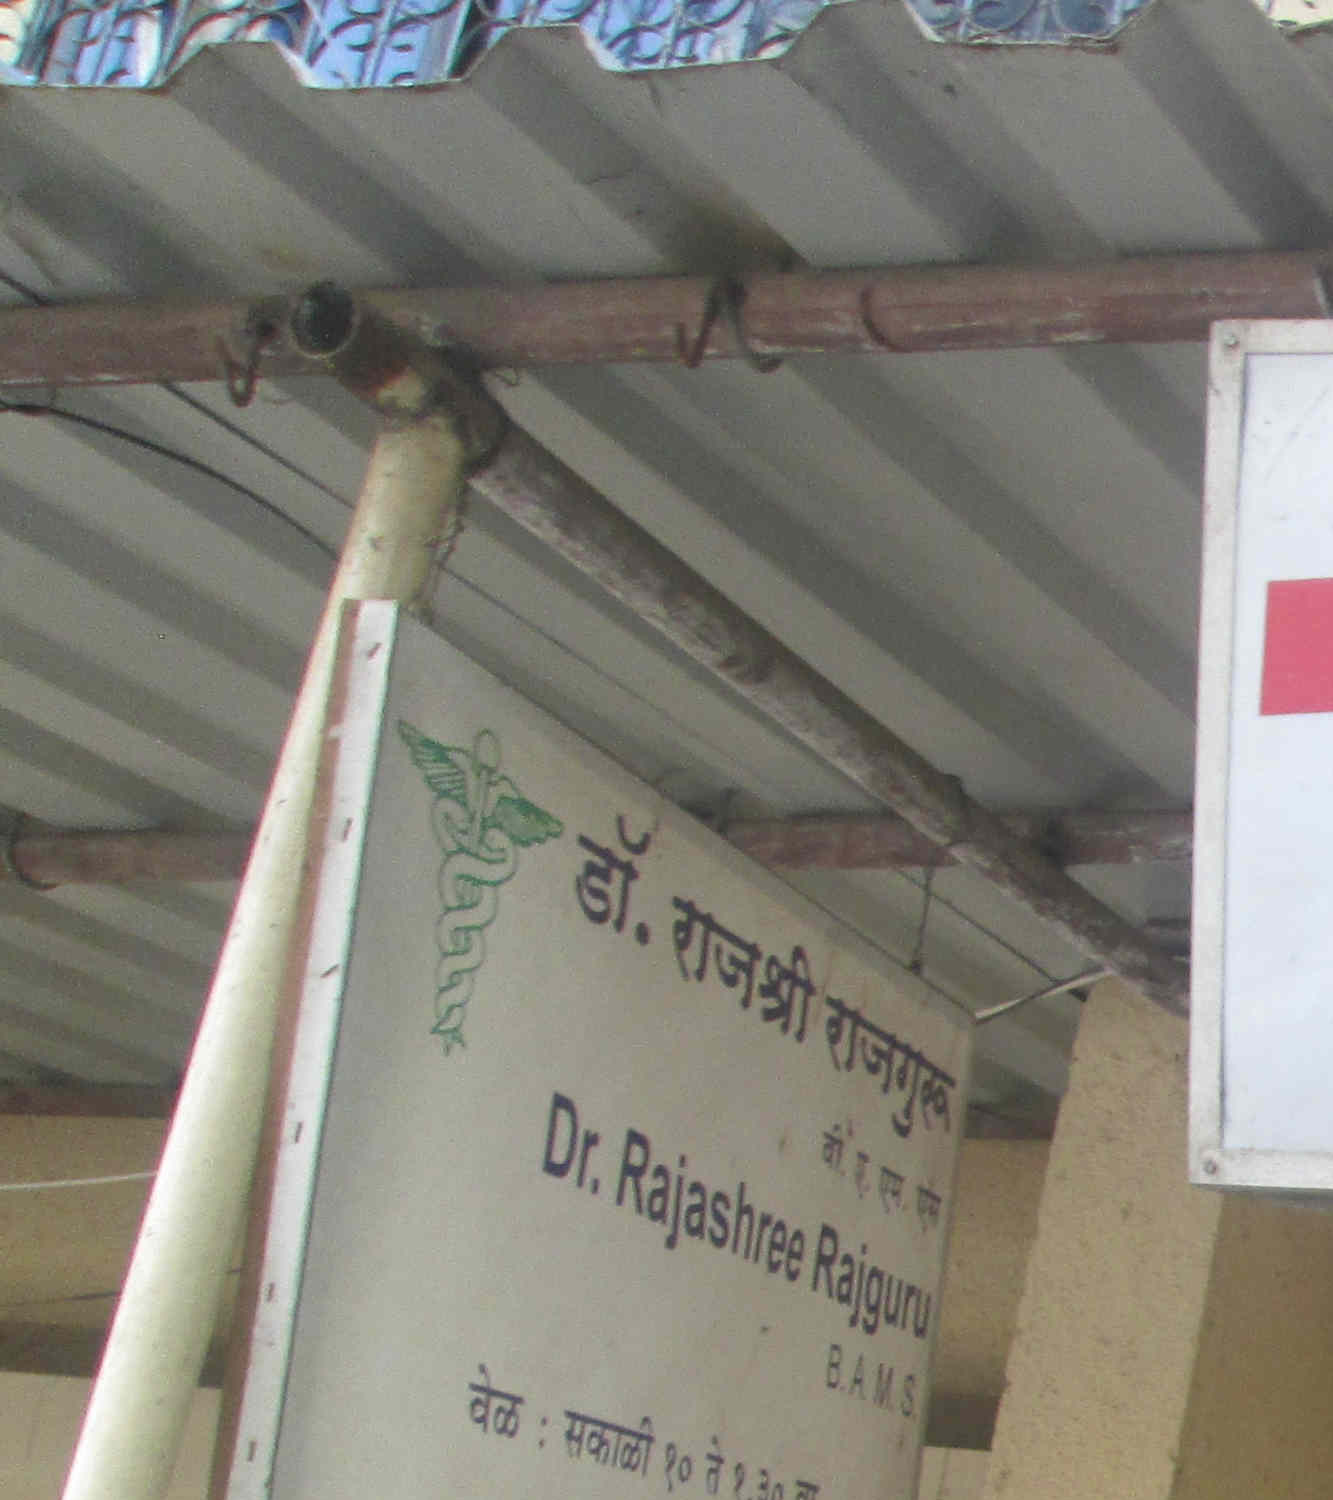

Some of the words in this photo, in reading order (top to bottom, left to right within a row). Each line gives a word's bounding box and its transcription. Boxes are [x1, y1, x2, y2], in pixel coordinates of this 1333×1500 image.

[672, 895, 816, 1042] राजश्री
[542, 1090, 600, 1195] Dr.
[616, 1127, 805, 1283] Rajashree
[811, 1221, 932, 1339] Rajguru
[562, 1409, 656, 1478] सकाळी
[705, 1434, 725, 1496] ते
